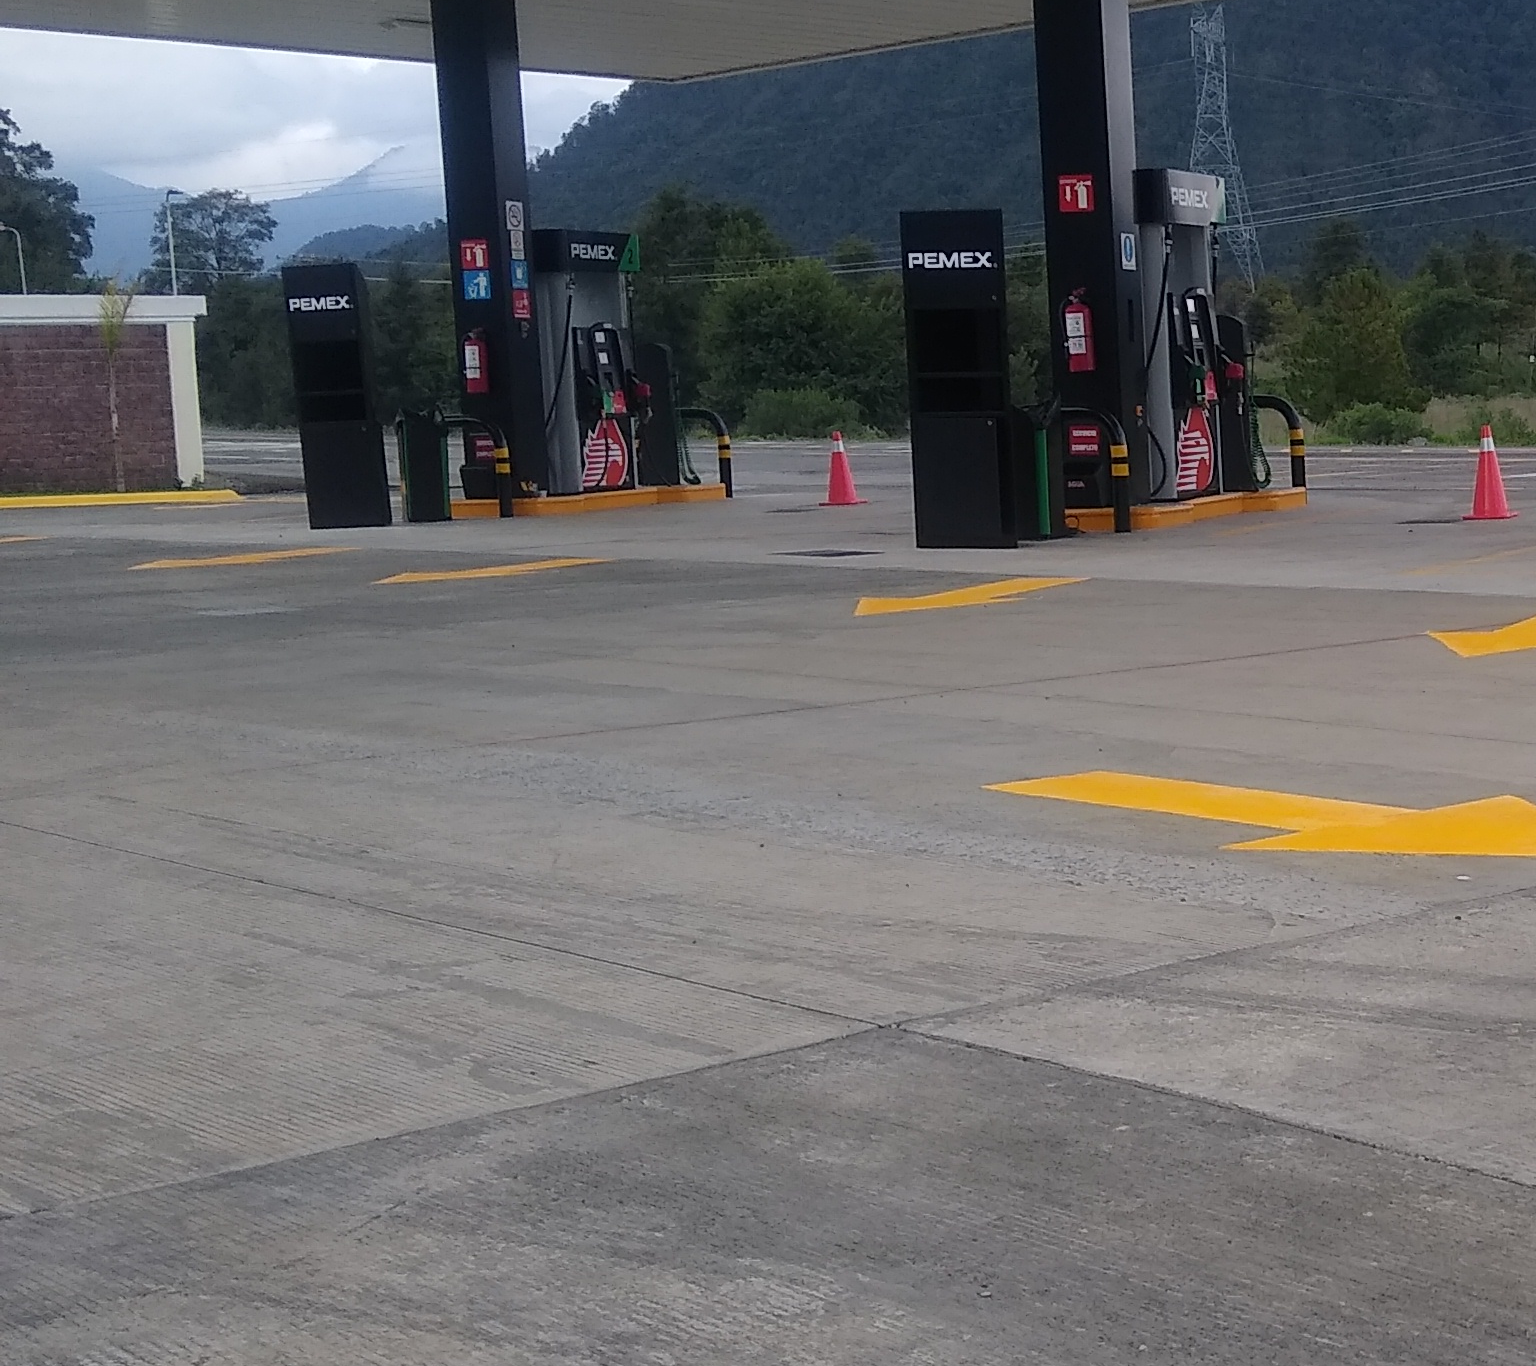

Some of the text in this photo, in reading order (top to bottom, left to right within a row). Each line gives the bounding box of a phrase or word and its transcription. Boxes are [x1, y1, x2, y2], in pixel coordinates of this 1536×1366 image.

[1171, 187, 1208, 208] PEMEX
[571, 243, 615, 260] PEMEX
[908, 251, 992, 268] PEMEX
[289, 295, 350, 311] PEMEX
